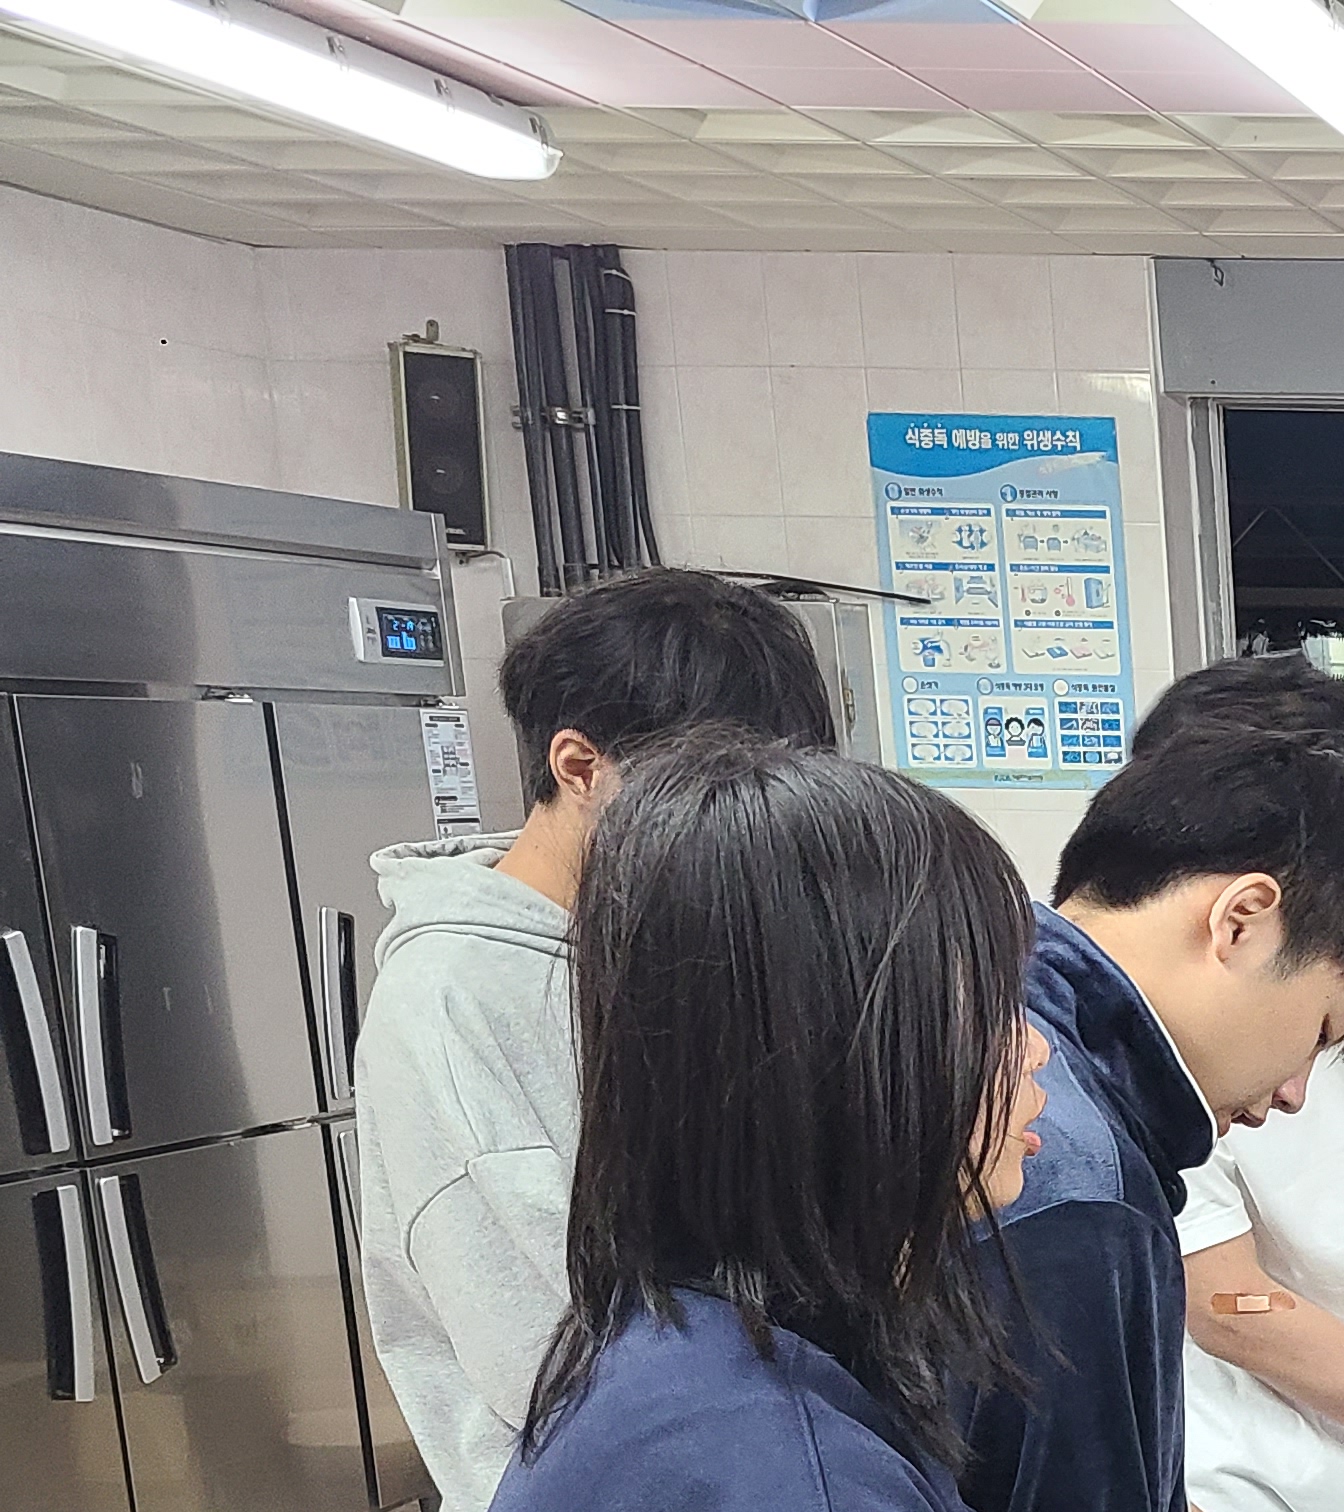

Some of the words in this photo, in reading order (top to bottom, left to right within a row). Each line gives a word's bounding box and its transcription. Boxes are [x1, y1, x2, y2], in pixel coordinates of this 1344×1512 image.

[906, 426, 948, 449] 식중독
[952, 429, 992, 449] 예방을
[995, 431, 1020, 450] 위한
[1023, 430, 1081, 451] 위생수칙
